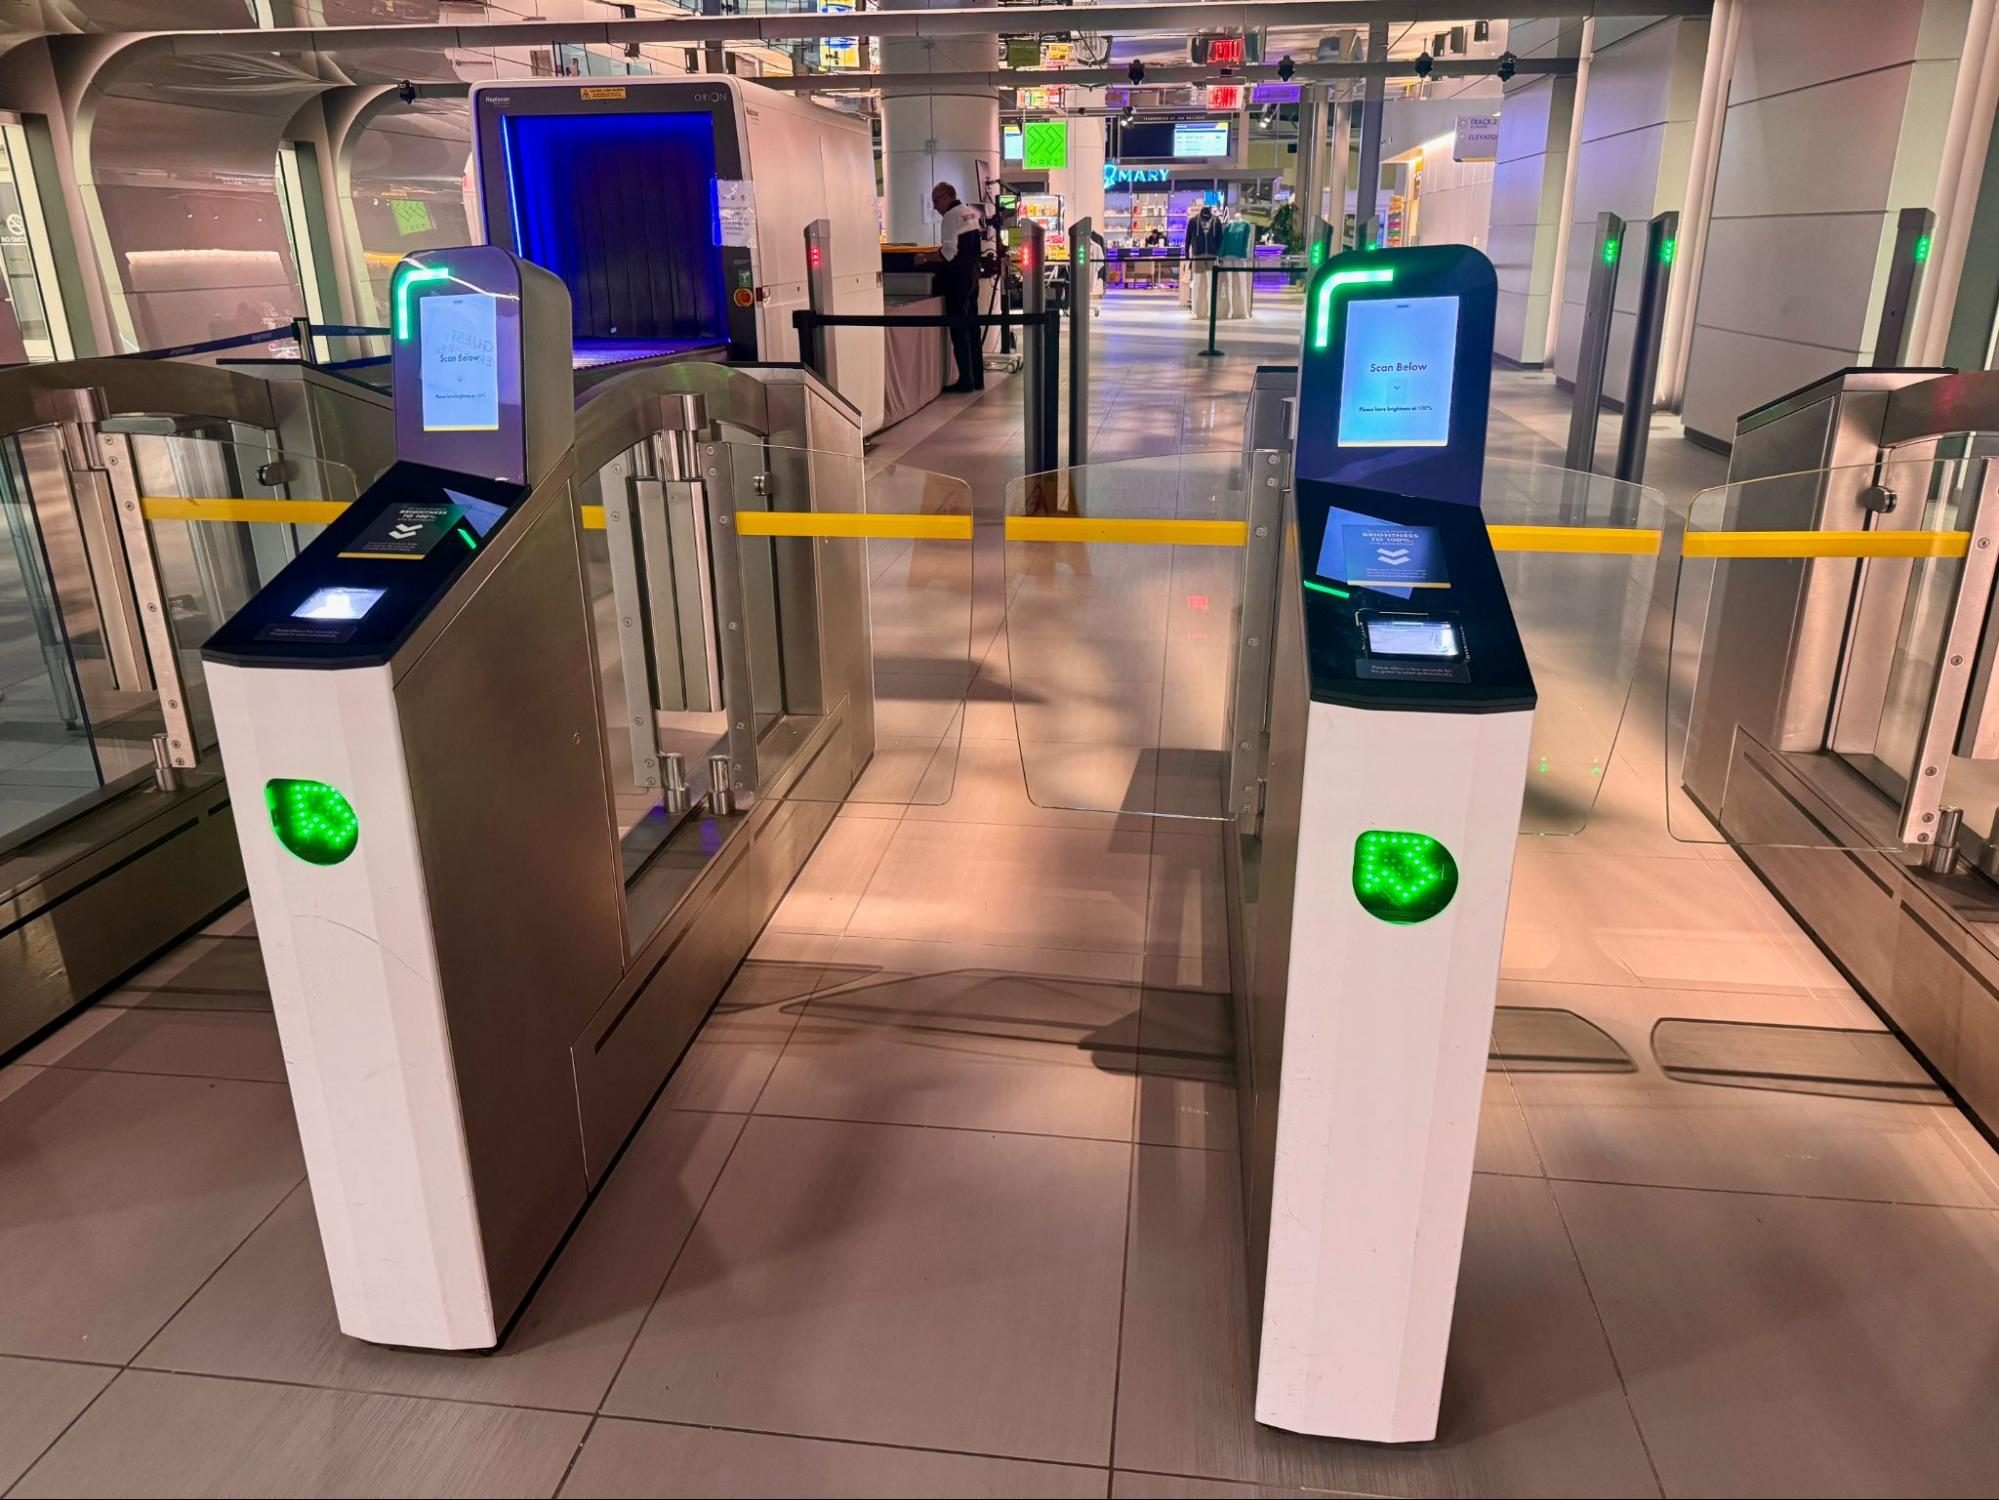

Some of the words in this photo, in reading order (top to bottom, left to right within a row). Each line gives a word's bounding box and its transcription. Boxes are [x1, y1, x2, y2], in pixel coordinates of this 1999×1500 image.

[1118, 169, 1170, 182] MARY
[440, 354, 457, 363] Scan
[1370, 363, 1393, 373] Scan
[1396, 362, 1427, 372] Below
